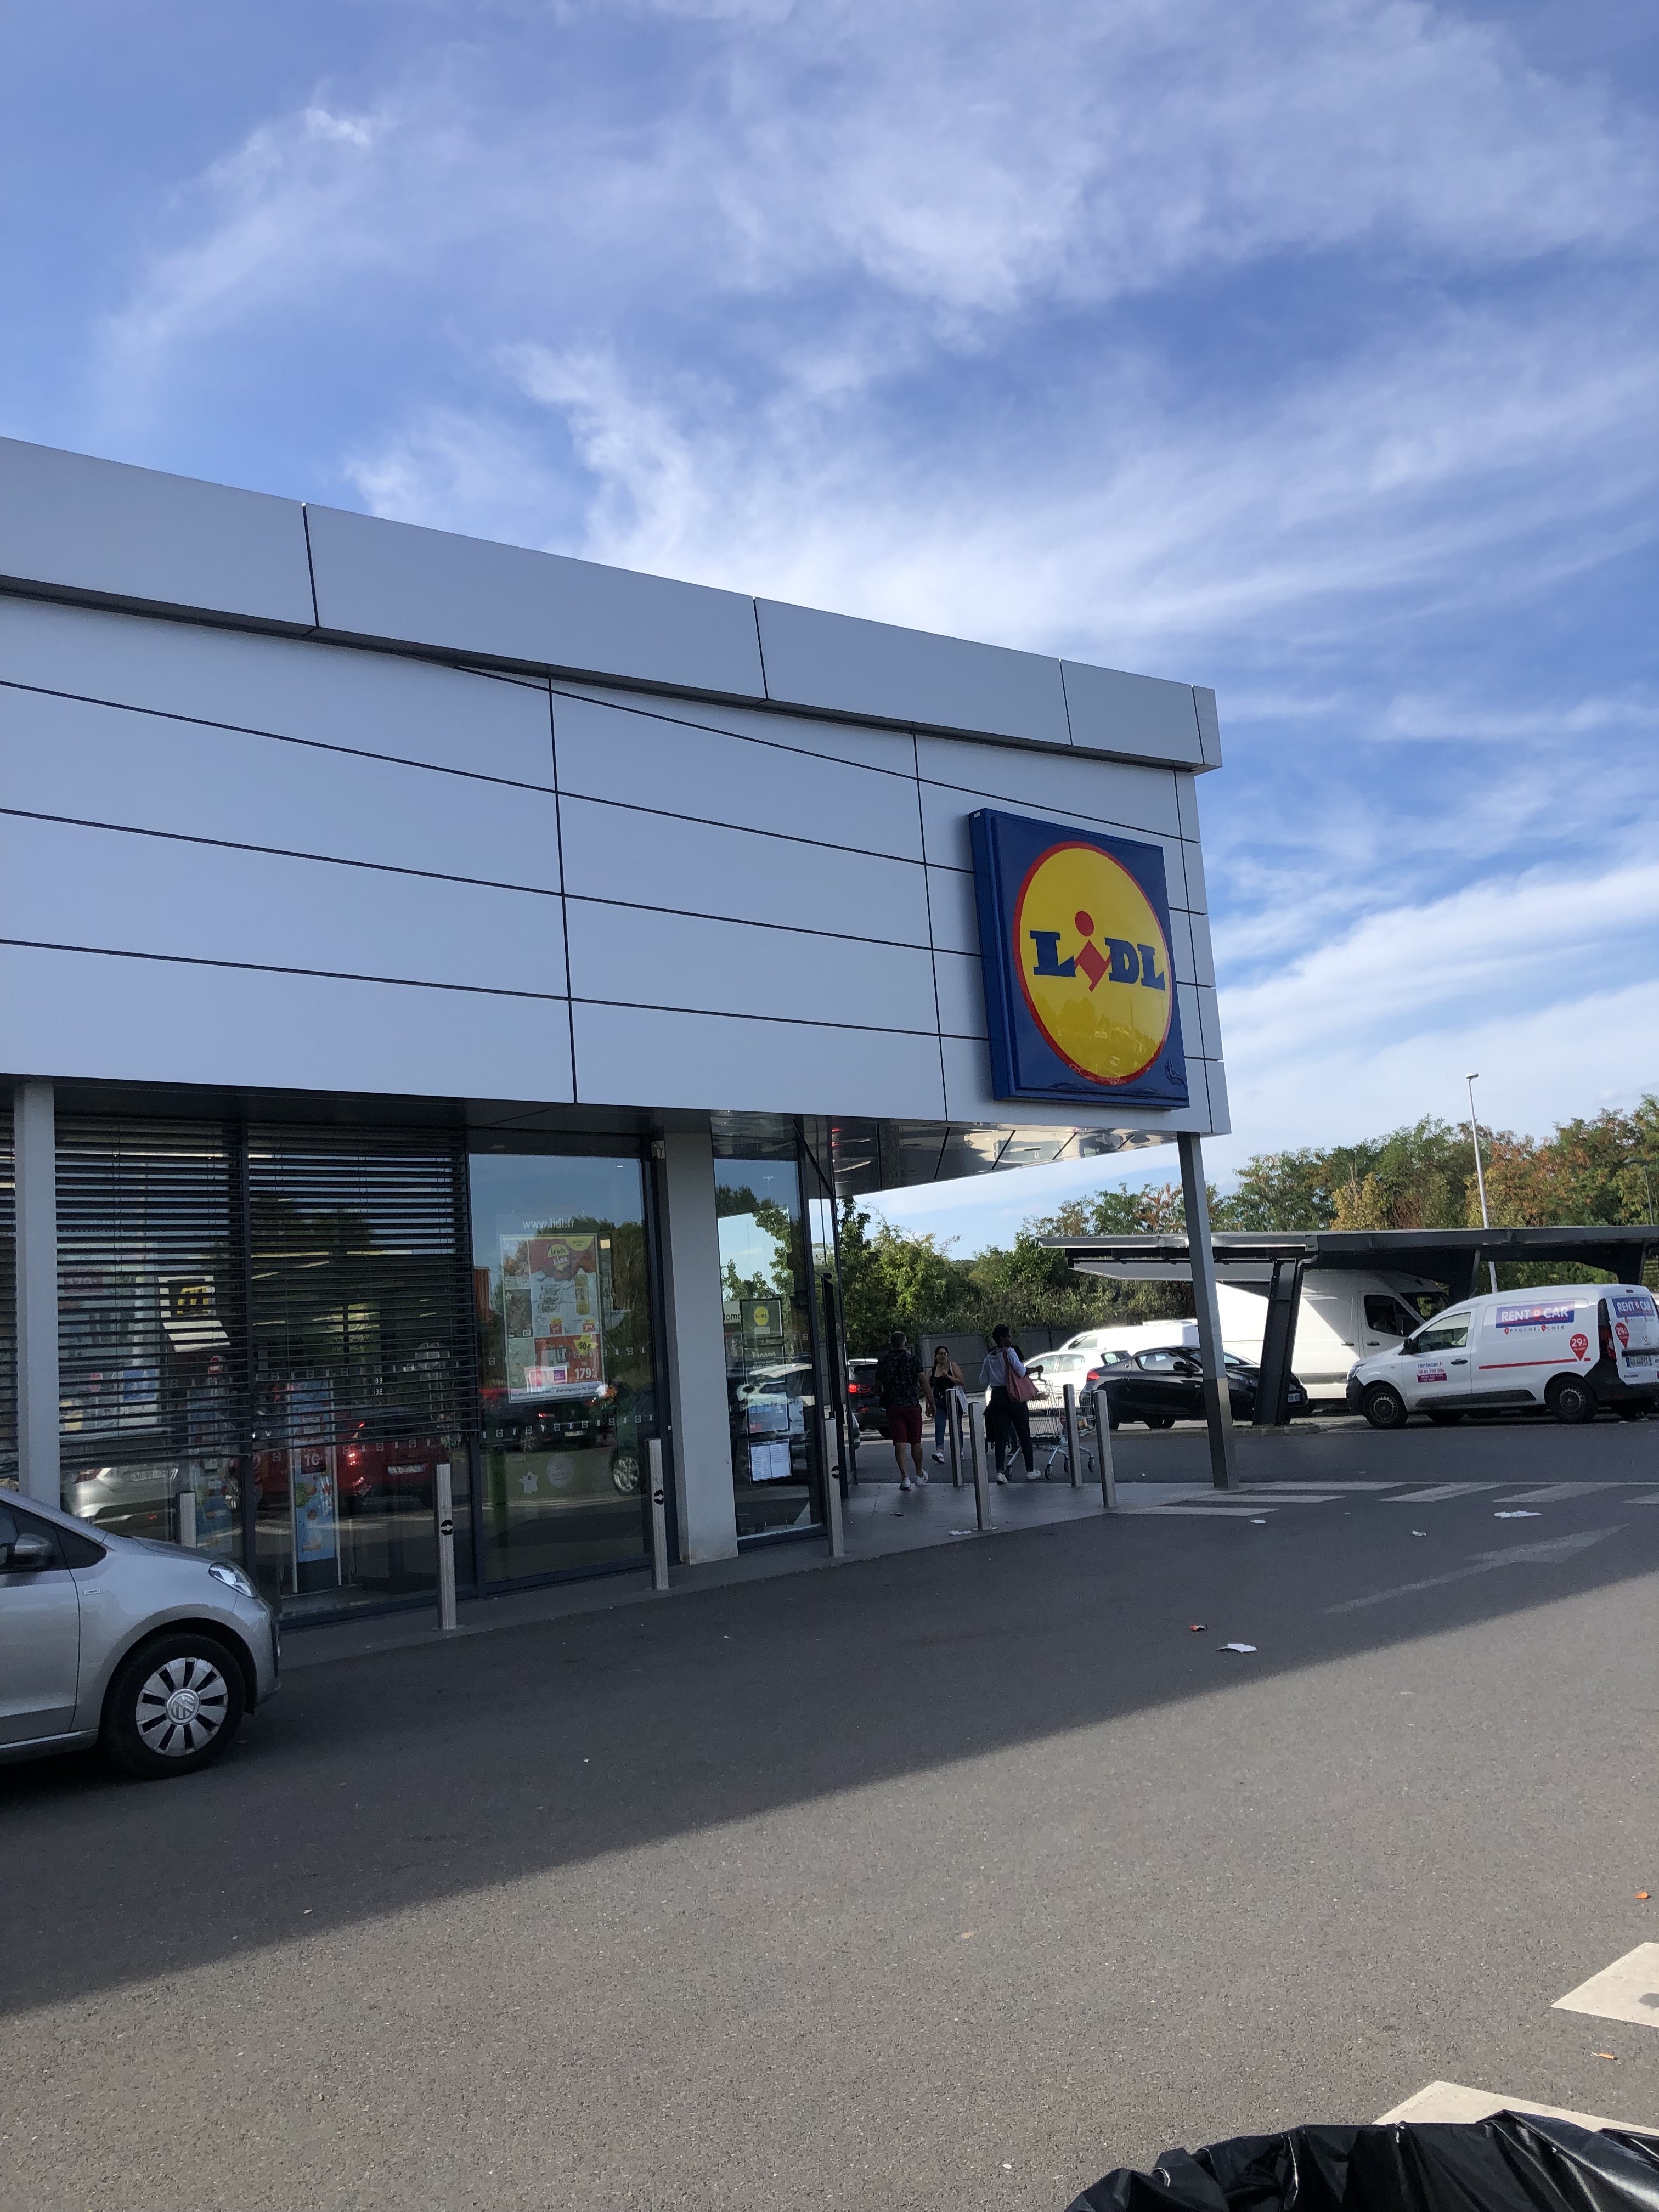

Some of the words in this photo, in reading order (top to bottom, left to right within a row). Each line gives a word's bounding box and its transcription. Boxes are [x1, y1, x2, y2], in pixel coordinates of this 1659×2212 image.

[522, 1218, 575, 1229] www.lidl.fr
[1617, 1301, 1635, 1312] RENT
[1640, 1301, 1652, 1311] CAR
[1501, 1309, 1531, 1322] RENT
[1543, 1306, 1568, 1318] CAR
